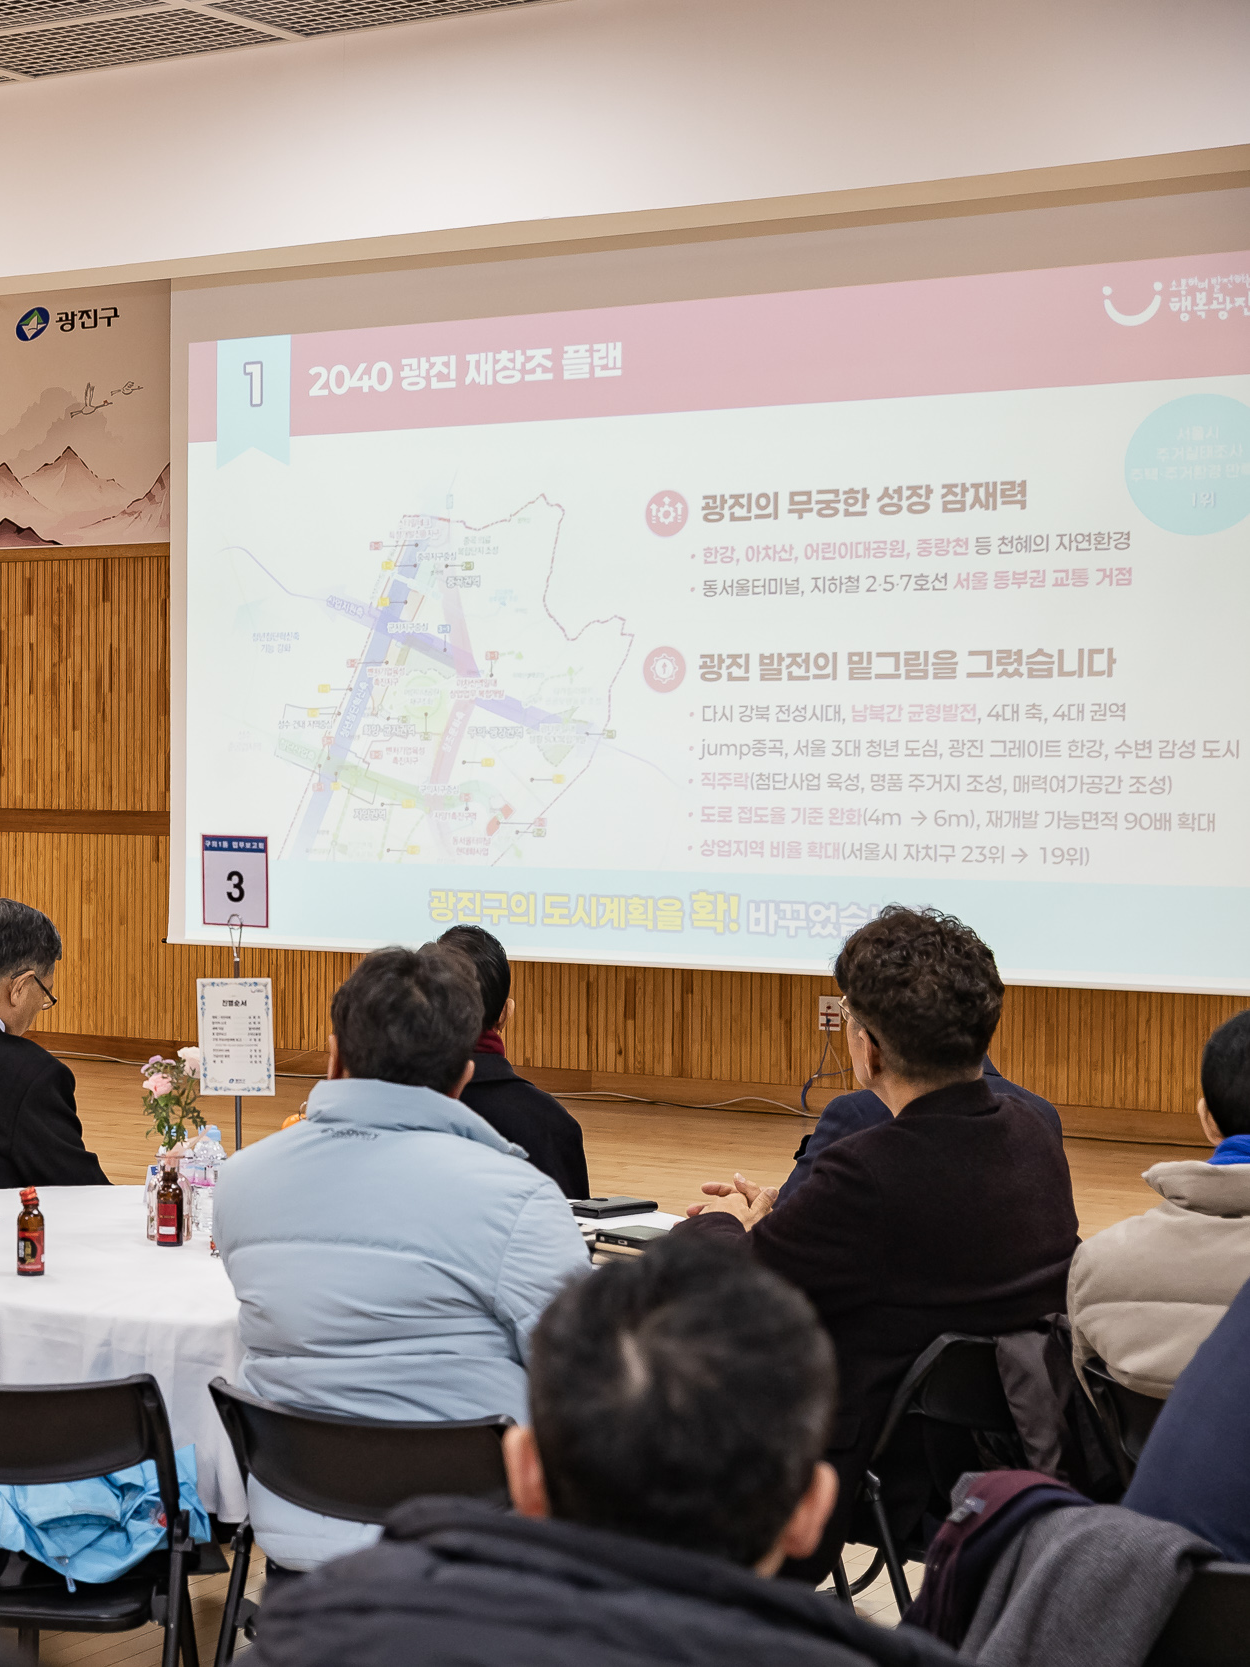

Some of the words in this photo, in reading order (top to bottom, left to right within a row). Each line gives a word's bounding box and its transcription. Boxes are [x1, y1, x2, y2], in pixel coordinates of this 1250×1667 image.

[55, 306, 120, 333] 광진구
[243, 360, 263, 408] 1
[308, 361, 393, 397] 2040
[400, 355, 457, 391] 광진
[464, 349, 554, 386] 재창조
[561, 341, 623, 379] 플랜
[701, 491, 779, 524] 광진의
[787, 487, 870, 520] 무궁한
[877, 484, 934, 516] 성장
[941, 479, 1028, 514] 잠재력
[703, 546, 740, 566] 한강,
[745, 543, 799, 564] 아차산,
[804, 539, 910, 561] 어린이대공원,
[916, 537, 969, 558] 중랑천
[975, 536, 992, 556] 등
[997, 533, 1050, 556] 천혜의
[1055, 530, 1131, 552] 자연환경
[702, 577, 805, 598] 동서울터미널,
[811, 575, 860, 595] 지하철
[953, 571, 988, 591] 서울
[993, 569, 1046, 590] 동부권
[1052, 567, 1089, 588] 교통
[1095, 566, 1133, 588] 거점
[699, 653, 751, 683] 광진
[759, 651, 838, 682] 발전의
[847, 649, 959, 681] 밑그림을
[966, 647, 1117, 680] 그렸습니다
[702, 704, 734, 723] 다시
[739, 704, 770, 723] 강북
[775, 704, 846, 725] 전성시대,
[851, 703, 903, 723] 남북간
[908, 702, 982, 725] 균형발전,
[986, 703, 1020, 723] 4대
[1025, 703, 1048, 725] 축,
[1052, 703, 1085, 723] 4대
[1090, 702, 1126, 723] 권역
[699, 739, 789, 760] jump중곡,
[793, 739, 826, 757] 서울
[831, 739, 861, 757] 3대
[866, 739, 899, 759] 청년
[905, 740, 943, 760] 도심,
[948, 739, 984, 759] 광진
[989, 739, 1062, 759] 그레이트
[1067, 739, 1109, 761] 한강,
[1114, 739, 1152, 759] 수변
[1158, 739, 1196, 759] 감성
[1202, 739, 1240, 760] 도시
[701, 772, 821, 791] 직주락(첨단사업
[827, 773, 865, 793] 육성,
[870, 774, 903, 792] 명품
[908, 774, 961, 793] 주거지
[966, 774, 1008, 795] 조성,
[1013, 774, 1123, 795] 매력여가공간
[1128, 775, 1173, 795] 조성)
[700, 806, 733, 824] 도로
[738, 806, 786, 825] 접도율
[791, 807, 824, 826] 기준
[828, 808, 902, 827] 완화(4m
[933, 809, 981, 831] 6m),
[985, 810, 1040, 830] 재개발
[1044, 811, 1118, 831] 가능면적
[1124, 812, 1172, 832] 90배
[1177, 812, 1216, 833] 확대
[700, 839, 765, 859] 상업지역
[770, 841, 802, 859] 비율
[807, 841, 898, 861] 확대(서울시
[903, 844, 956, 863] 자치구
[961, 846, 1005, 865] 23위
[1039, 847, 1090, 867] 19위)
[226, 870, 245, 902] 3
[428, 889, 536, 925] 광진구의
[542, 893, 684, 931] 도시계획을
[691, 890, 740, 934] 확!
[748, 900, 880, 938] 바꾸었습
